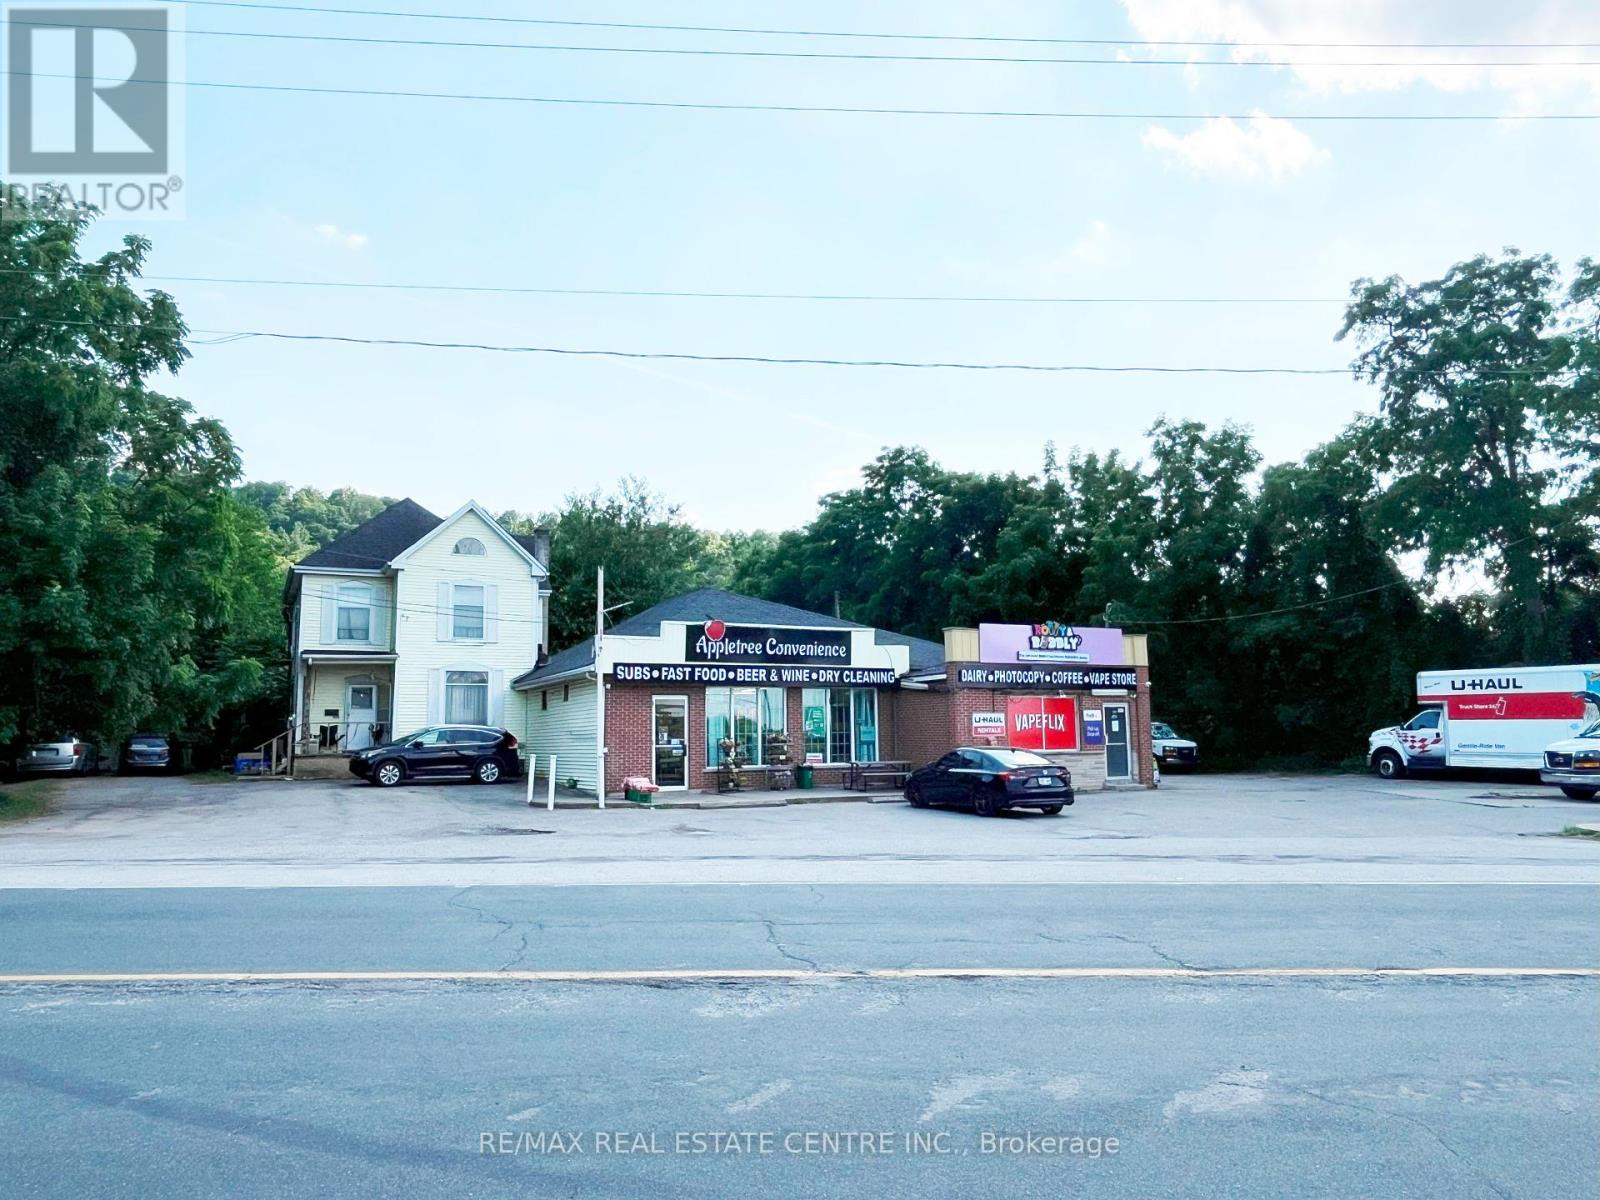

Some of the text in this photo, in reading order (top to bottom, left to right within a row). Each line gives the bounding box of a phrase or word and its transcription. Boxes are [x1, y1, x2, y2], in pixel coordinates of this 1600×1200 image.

[696, 634, 847, 659] Appletree Convenience
[616, 666, 896, 684] SUBS FAST FOOD BEER & WINE DRY CLEANING
[961, 669, 1137, 685] DAIRY PHOTOCOPY COFFEE VAPE STORE
[1450, 677, 1523, 691] U-HAUL
[974, 716, 1003, 724] U-HAUL
[1014, 713, 1065, 732] VAPEFLIX
